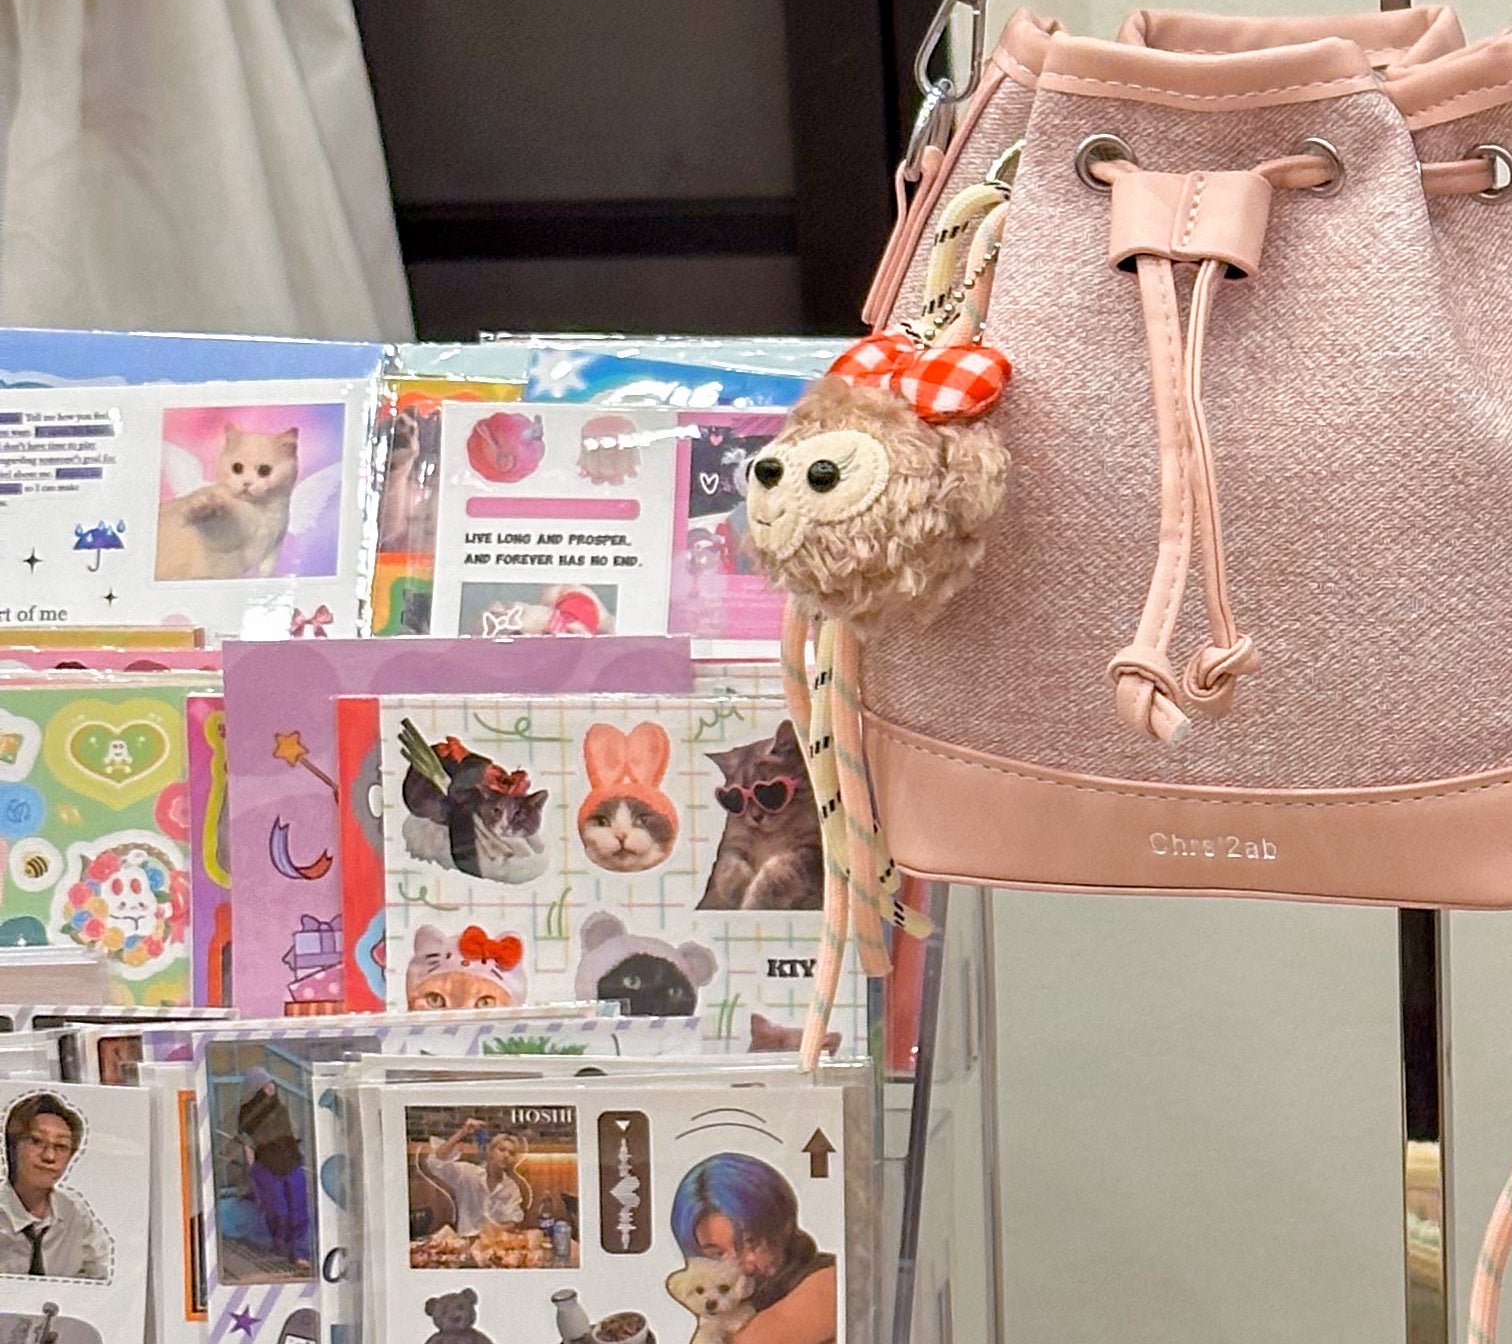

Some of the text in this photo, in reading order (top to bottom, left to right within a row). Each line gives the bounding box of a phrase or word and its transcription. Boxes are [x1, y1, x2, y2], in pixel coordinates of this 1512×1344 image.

[464, 533, 493, 544] LIVE
[497, 533, 531, 545] LONG
[537, 533, 563, 545] AND
[464, 554, 491, 565] AND
[496, 554, 553, 566] FOREVER
[17, 604, 37, 622] of
[40, 609, 68, 621] me
[511, 1109, 571, 1124] HOSHI
